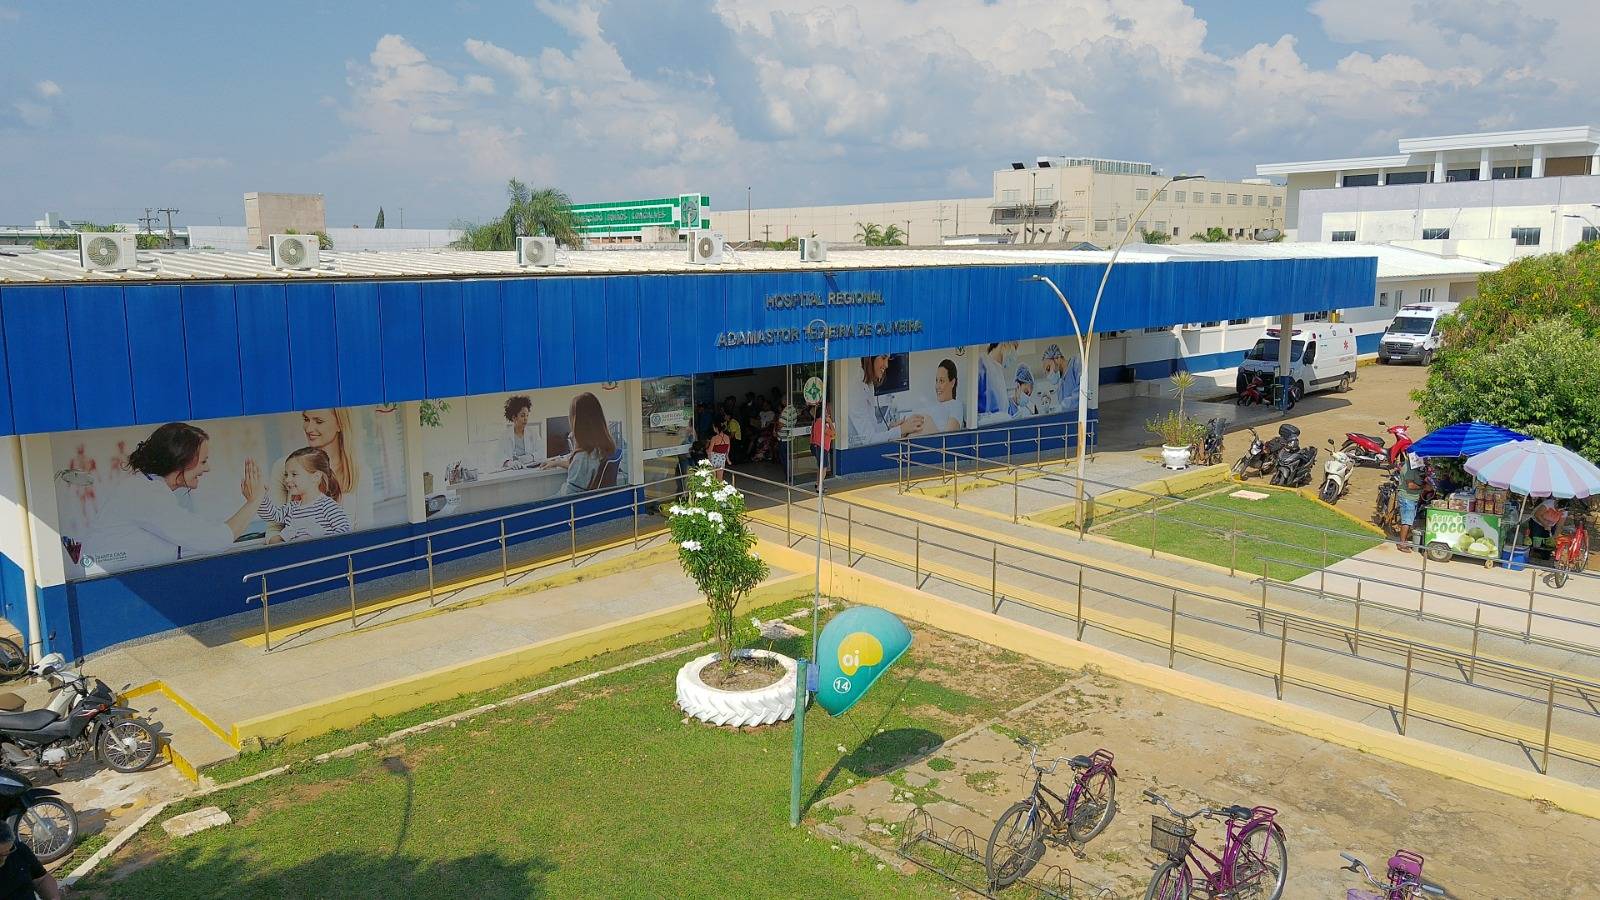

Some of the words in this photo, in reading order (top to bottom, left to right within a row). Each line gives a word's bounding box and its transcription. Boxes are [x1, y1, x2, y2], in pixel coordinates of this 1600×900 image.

[767, 292, 825, 309] HOSPITAL
[829, 290, 884, 305] REGIONAL
[715, 328, 800, 347] ADAMASTOR
[858, 323, 871, 337] DE
[1431, 522, 1465, 533] COCO
[835, 679, 848, 691] 14
